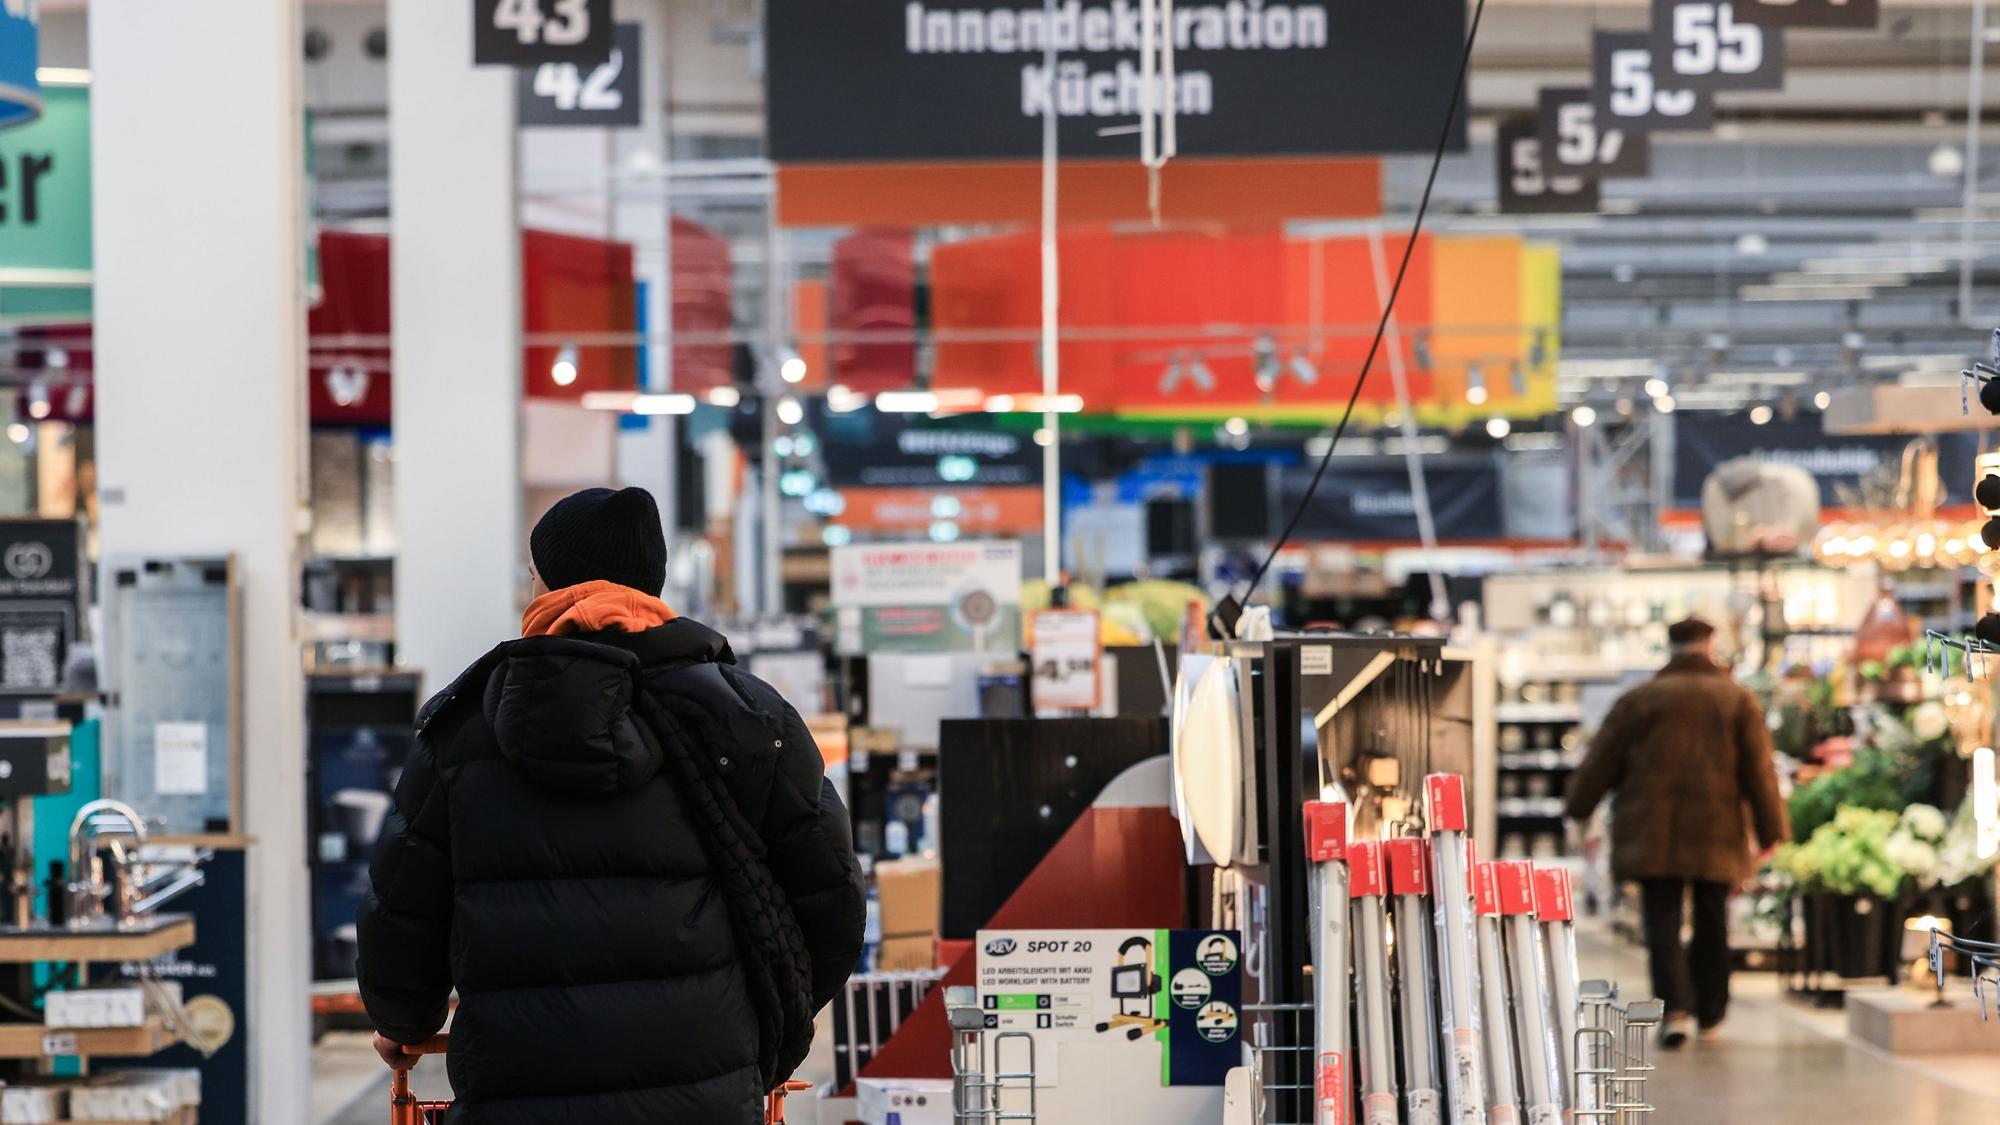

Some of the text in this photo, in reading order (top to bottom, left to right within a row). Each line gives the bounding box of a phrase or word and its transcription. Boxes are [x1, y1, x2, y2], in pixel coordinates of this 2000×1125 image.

[493, 0, 590, 45] 43
[1511, 138, 1584, 194] 5
[1027, 941, 1092, 953] SPOT 20
[982, 966, 1092, 975] LED ARBEITSLEUCHTE MIT AKKU
[982, 978, 996, 986] LED
[998, 978, 1038, 986] WORKLIGHT
[1060, 977, 1091, 985] BATTERY
